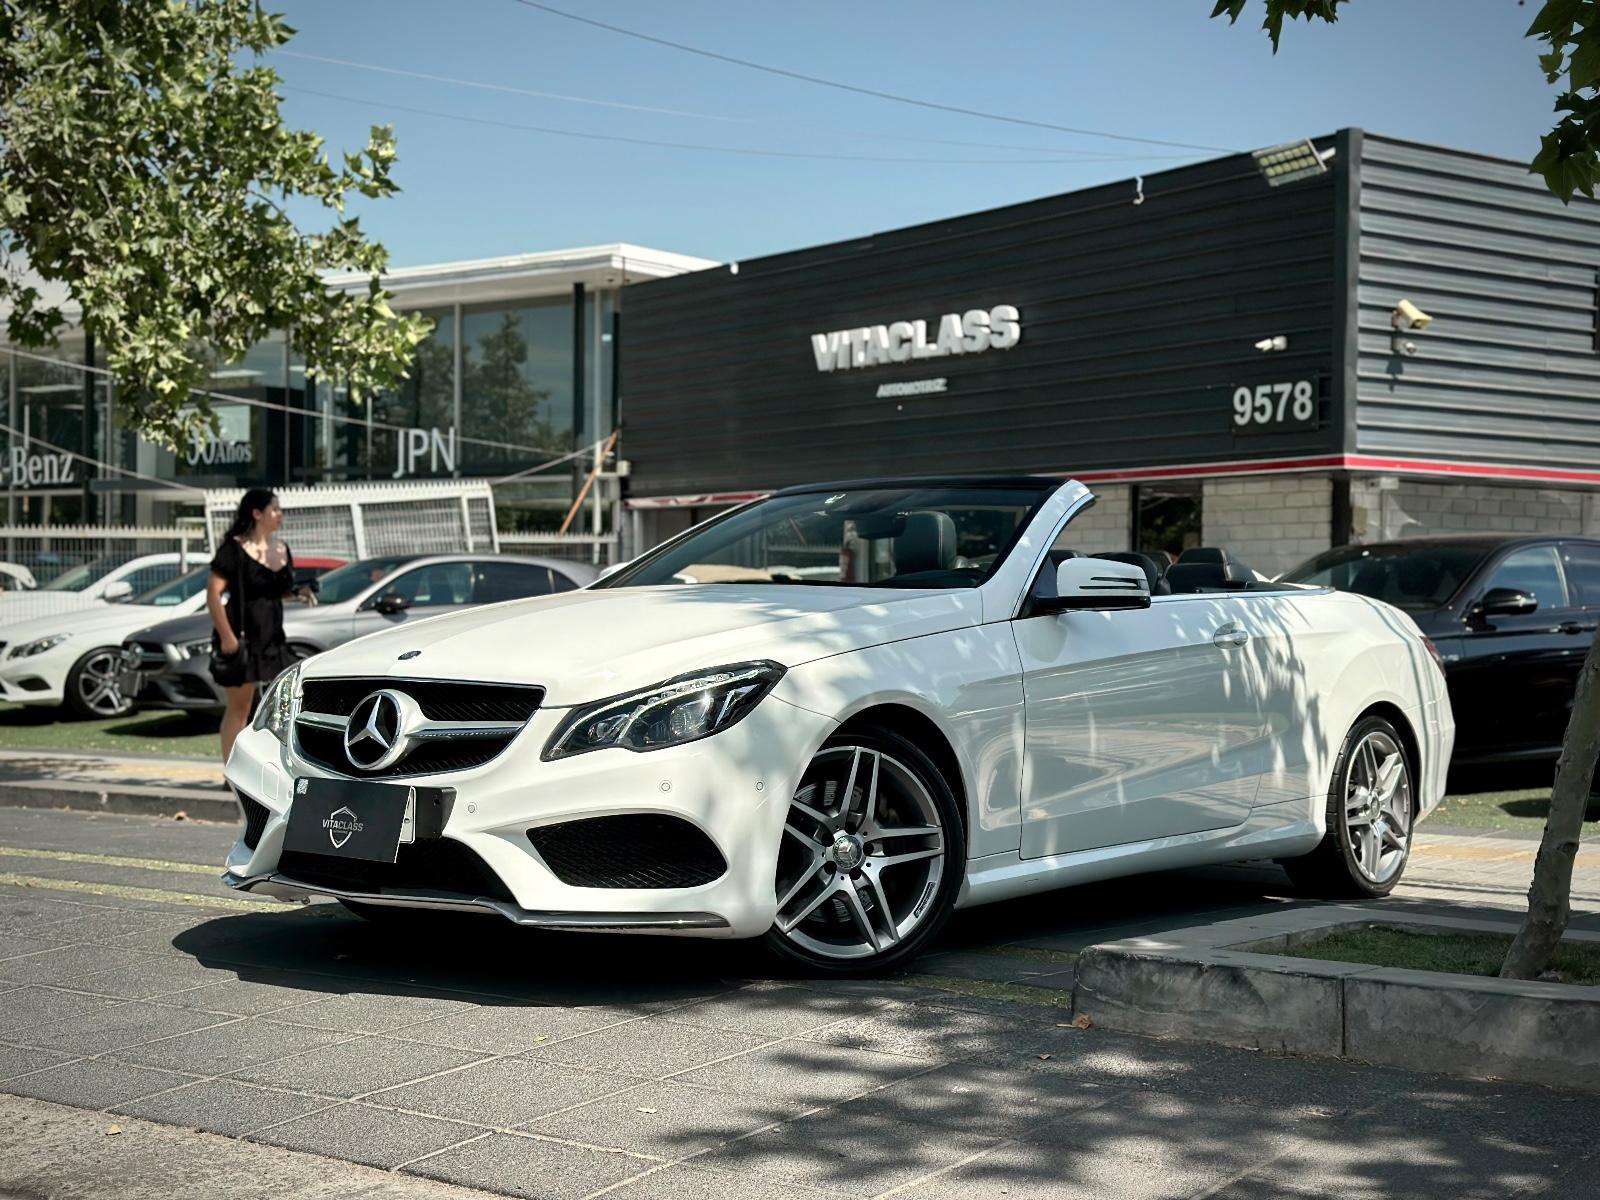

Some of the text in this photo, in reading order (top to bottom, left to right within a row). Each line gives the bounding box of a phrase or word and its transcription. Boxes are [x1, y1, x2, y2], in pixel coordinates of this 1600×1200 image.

[811, 305, 1020, 372] VITACLASS
[1233, 381, 1313, 426] 9578
[0, 446, 75, 485] -Benz
[392, 426, 455, 479] JPN
[322, 819, 364, 832] VITACLASS
